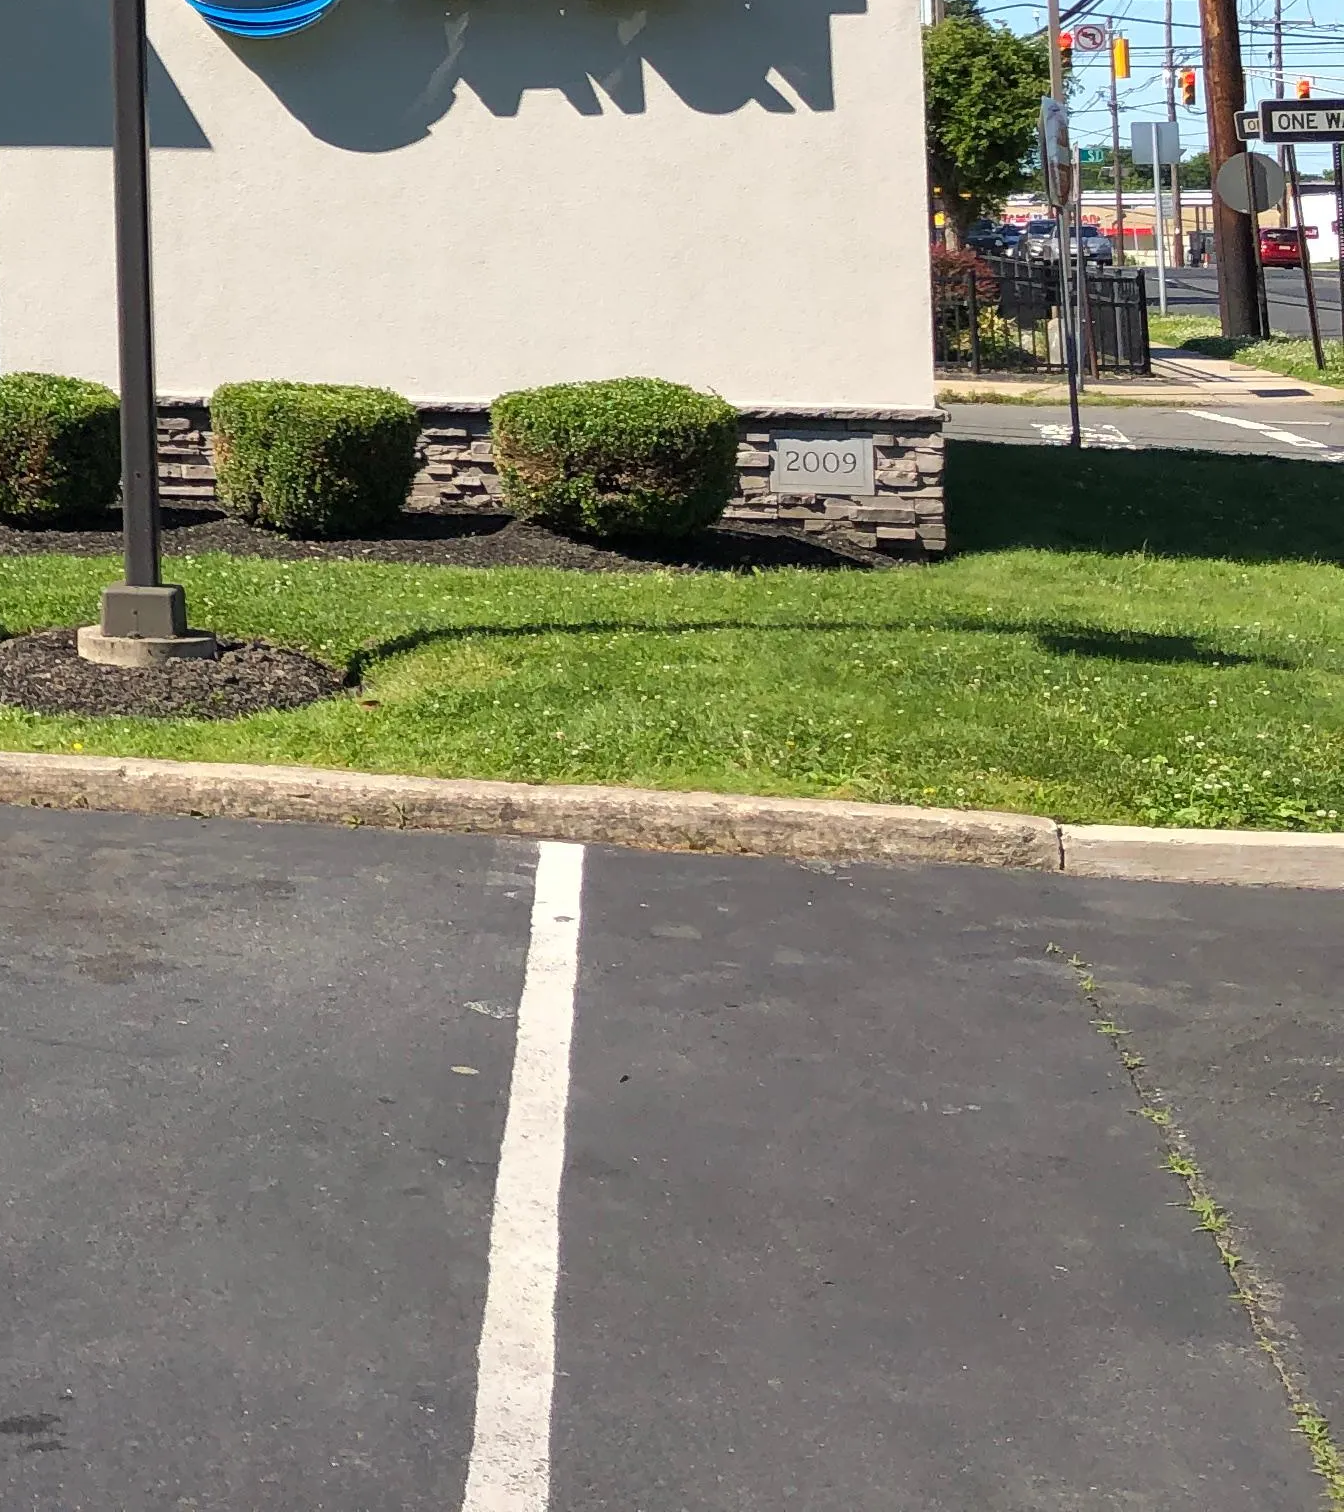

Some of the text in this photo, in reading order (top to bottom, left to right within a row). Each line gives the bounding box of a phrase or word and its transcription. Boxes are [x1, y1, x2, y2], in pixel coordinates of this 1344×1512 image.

[1278, 112, 1344, 130] ONE W
[785, 450, 857, 474] 2009
